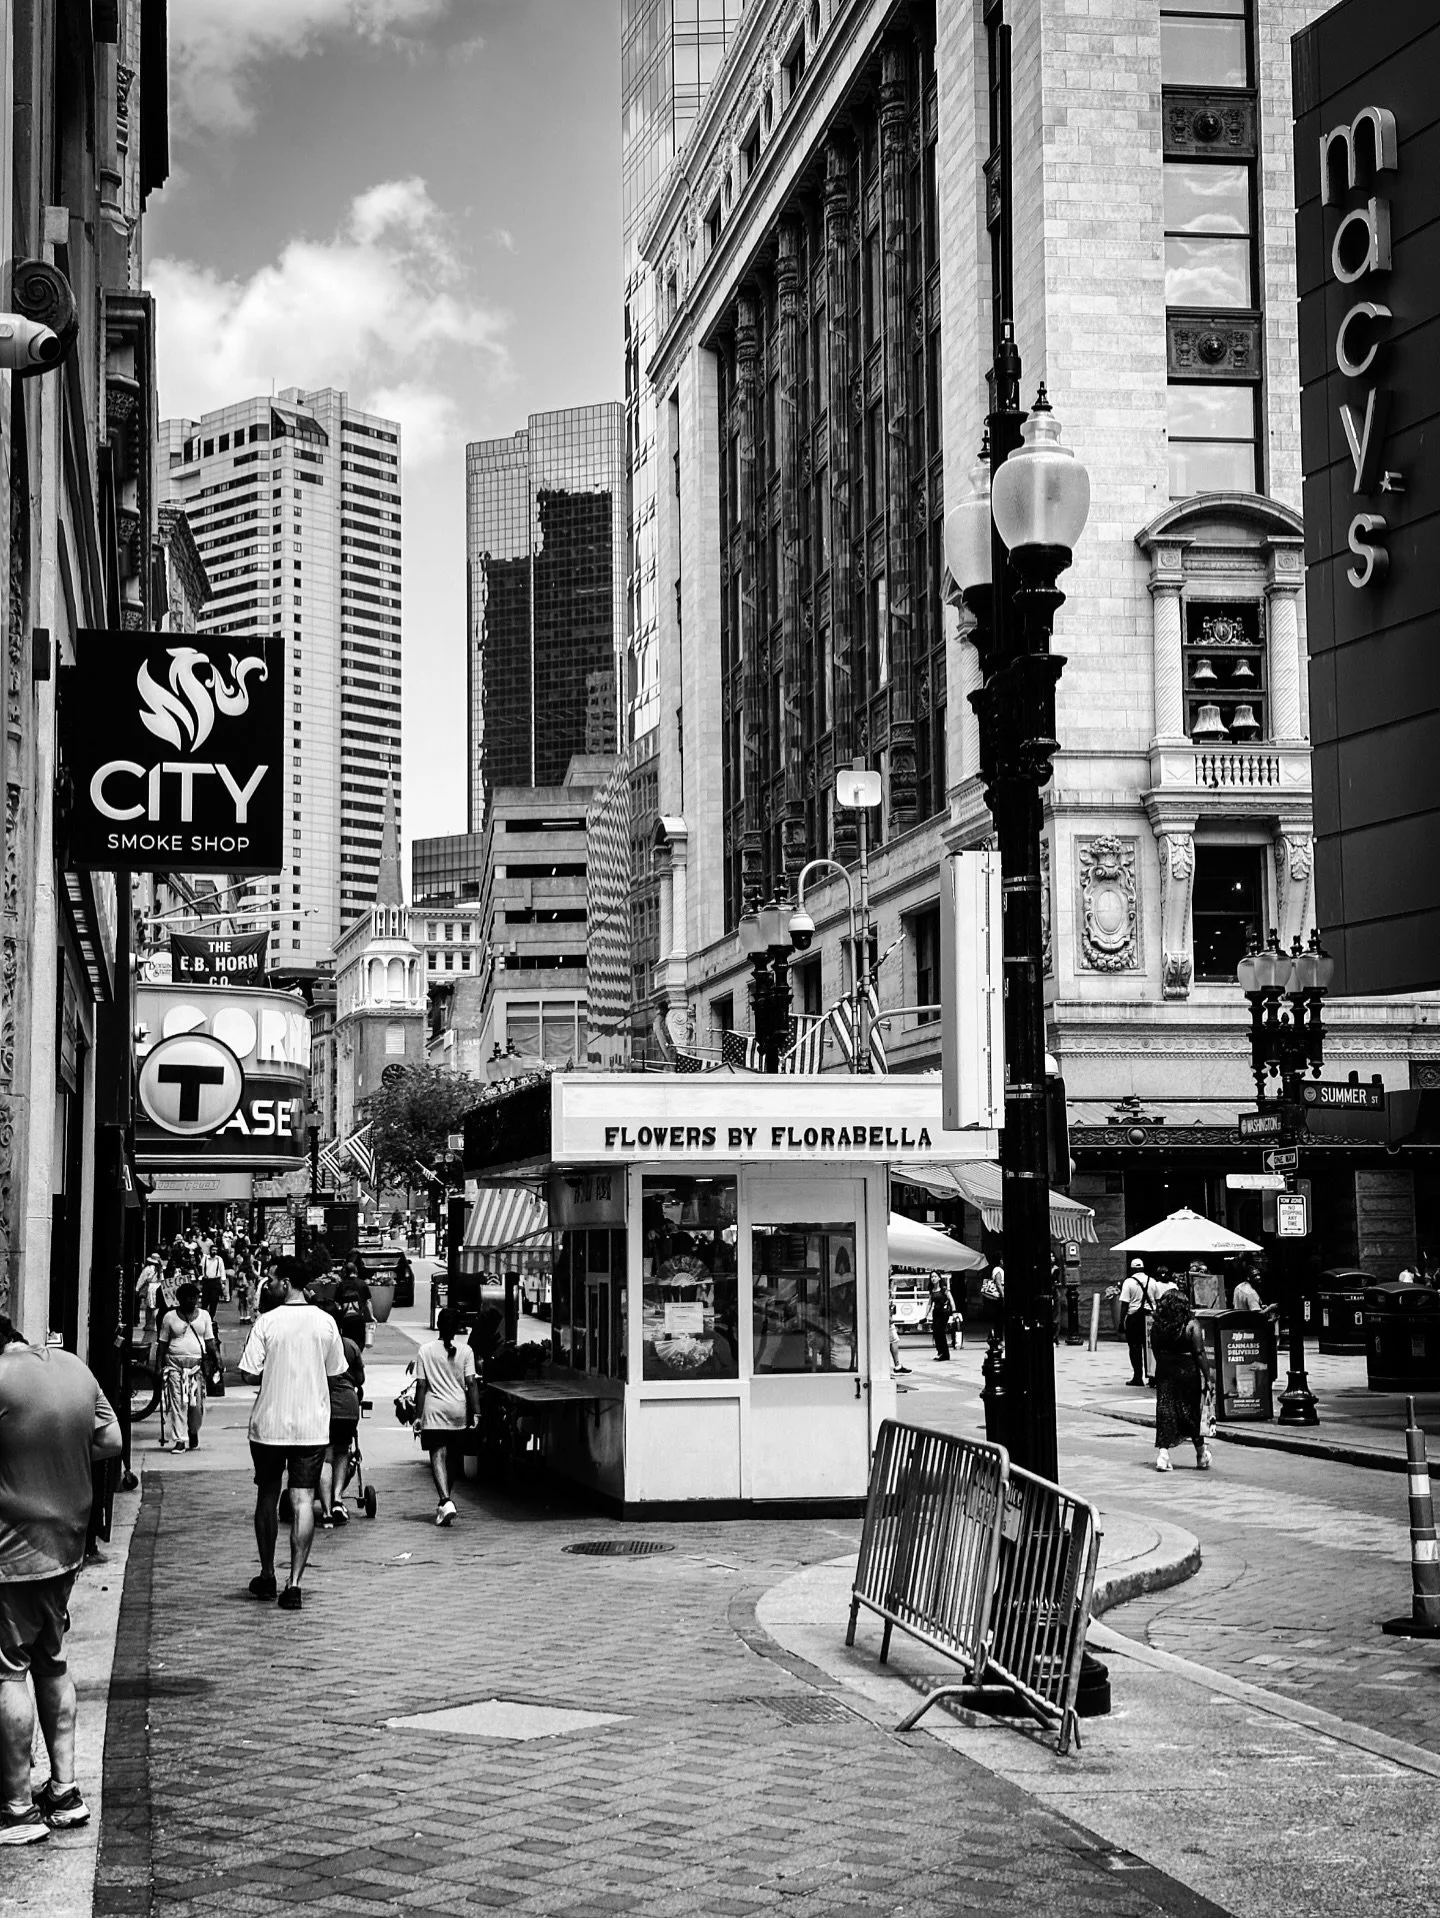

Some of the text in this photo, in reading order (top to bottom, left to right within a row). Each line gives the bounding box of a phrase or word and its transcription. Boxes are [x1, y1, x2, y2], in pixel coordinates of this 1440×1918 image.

[90, 760, 268, 823] CITY
[107, 834, 250, 852] SMOKE SHOP
[208, 941, 232, 953] THE
[180, 956, 210, 972] E.B.
[215, 953, 258, 972] HORN
[158, 1064, 224, 1121] T
[1321, 1087, 1367, 1104] SUMMER
[215, 1100, 292, 1136] ASE
[1247, 1117, 1277, 1133] WASHINGTON
[604, 1126, 932, 1147] FLOWERS BY FLORABELLA
[1274, 1155, 1284, 1164] ONE
